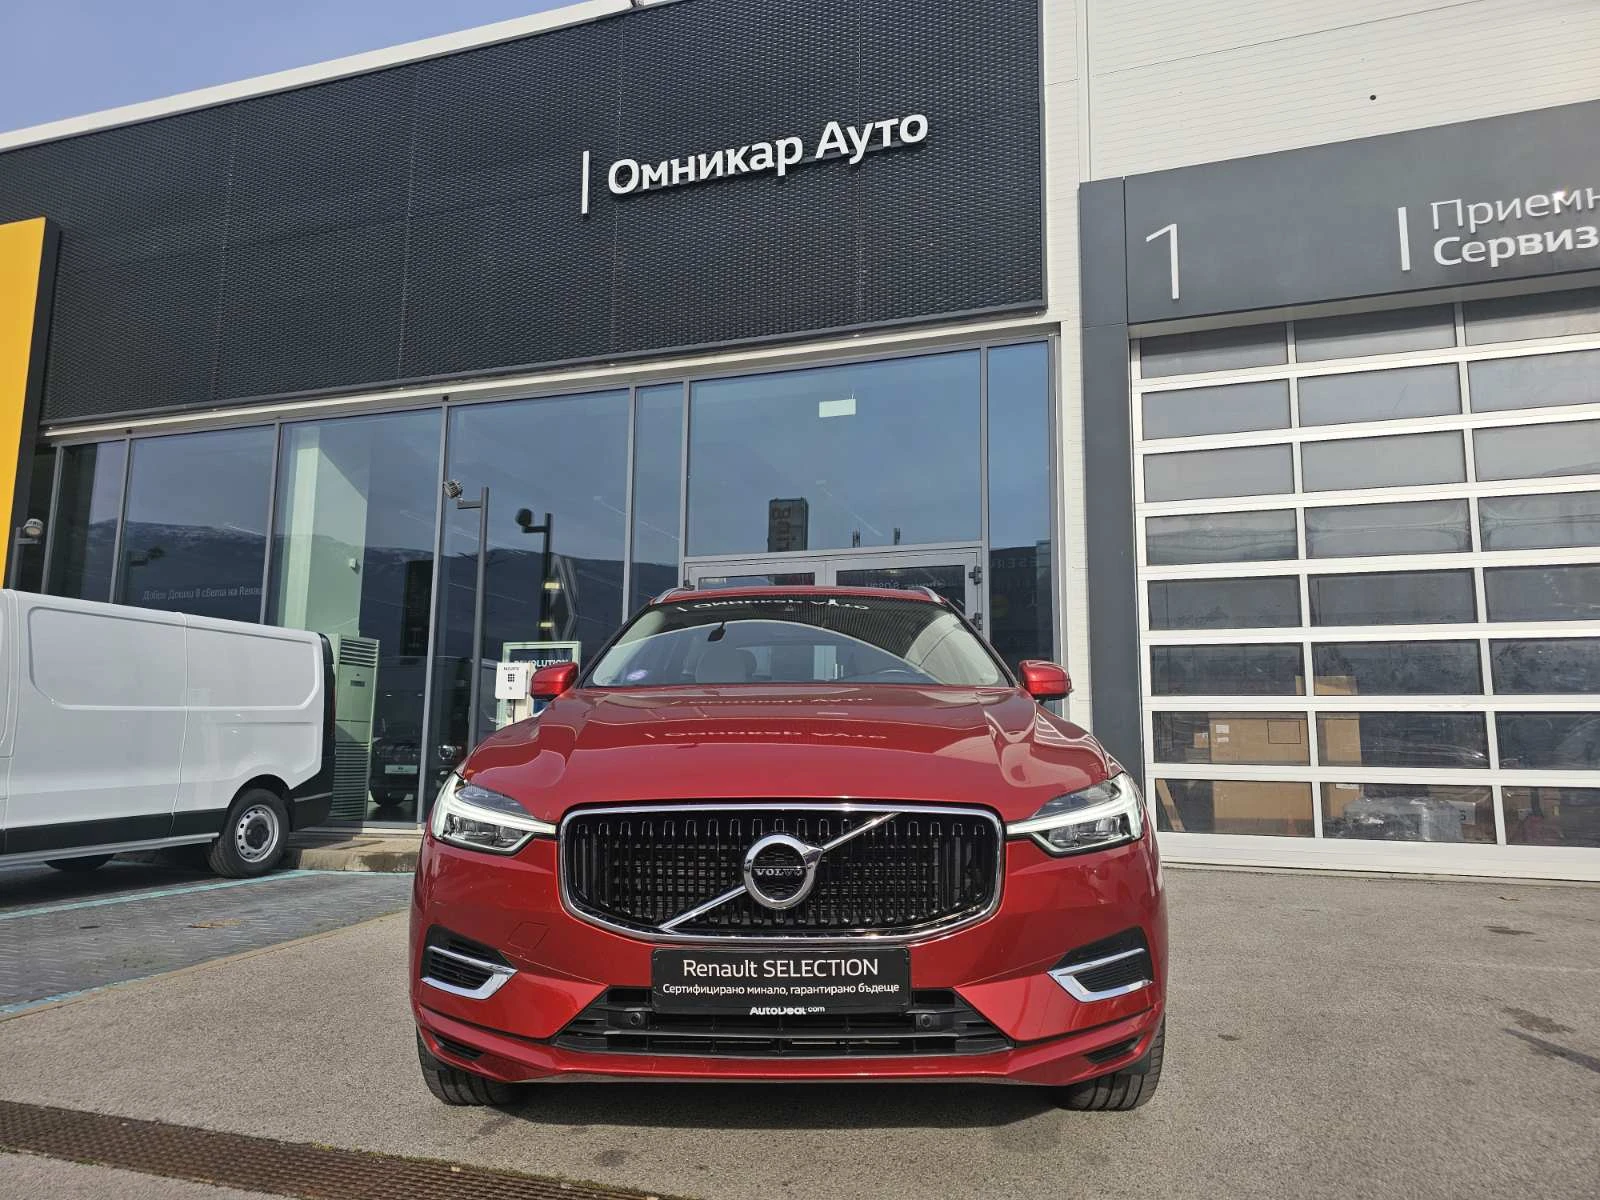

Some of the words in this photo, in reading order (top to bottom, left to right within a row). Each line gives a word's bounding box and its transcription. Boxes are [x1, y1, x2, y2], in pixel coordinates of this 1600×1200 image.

[608, 136, 803, 195] Омникар
[815, 114, 928, 165] Ауто
[1146, 223, 1180, 300] 1
[1432, 226, 1600, 267] Сервиз
[754, 868, 803, 876] VOLVO
[683, 959, 758, 978] Renault
[763, 958, 879, 977] SELECTION
[662, 983, 745, 996] Сертифицирано
[747, 986, 789, 996] минало,
[790, 984, 857, 996] гарантирано
[858, 983, 900, 994] бъдеще
